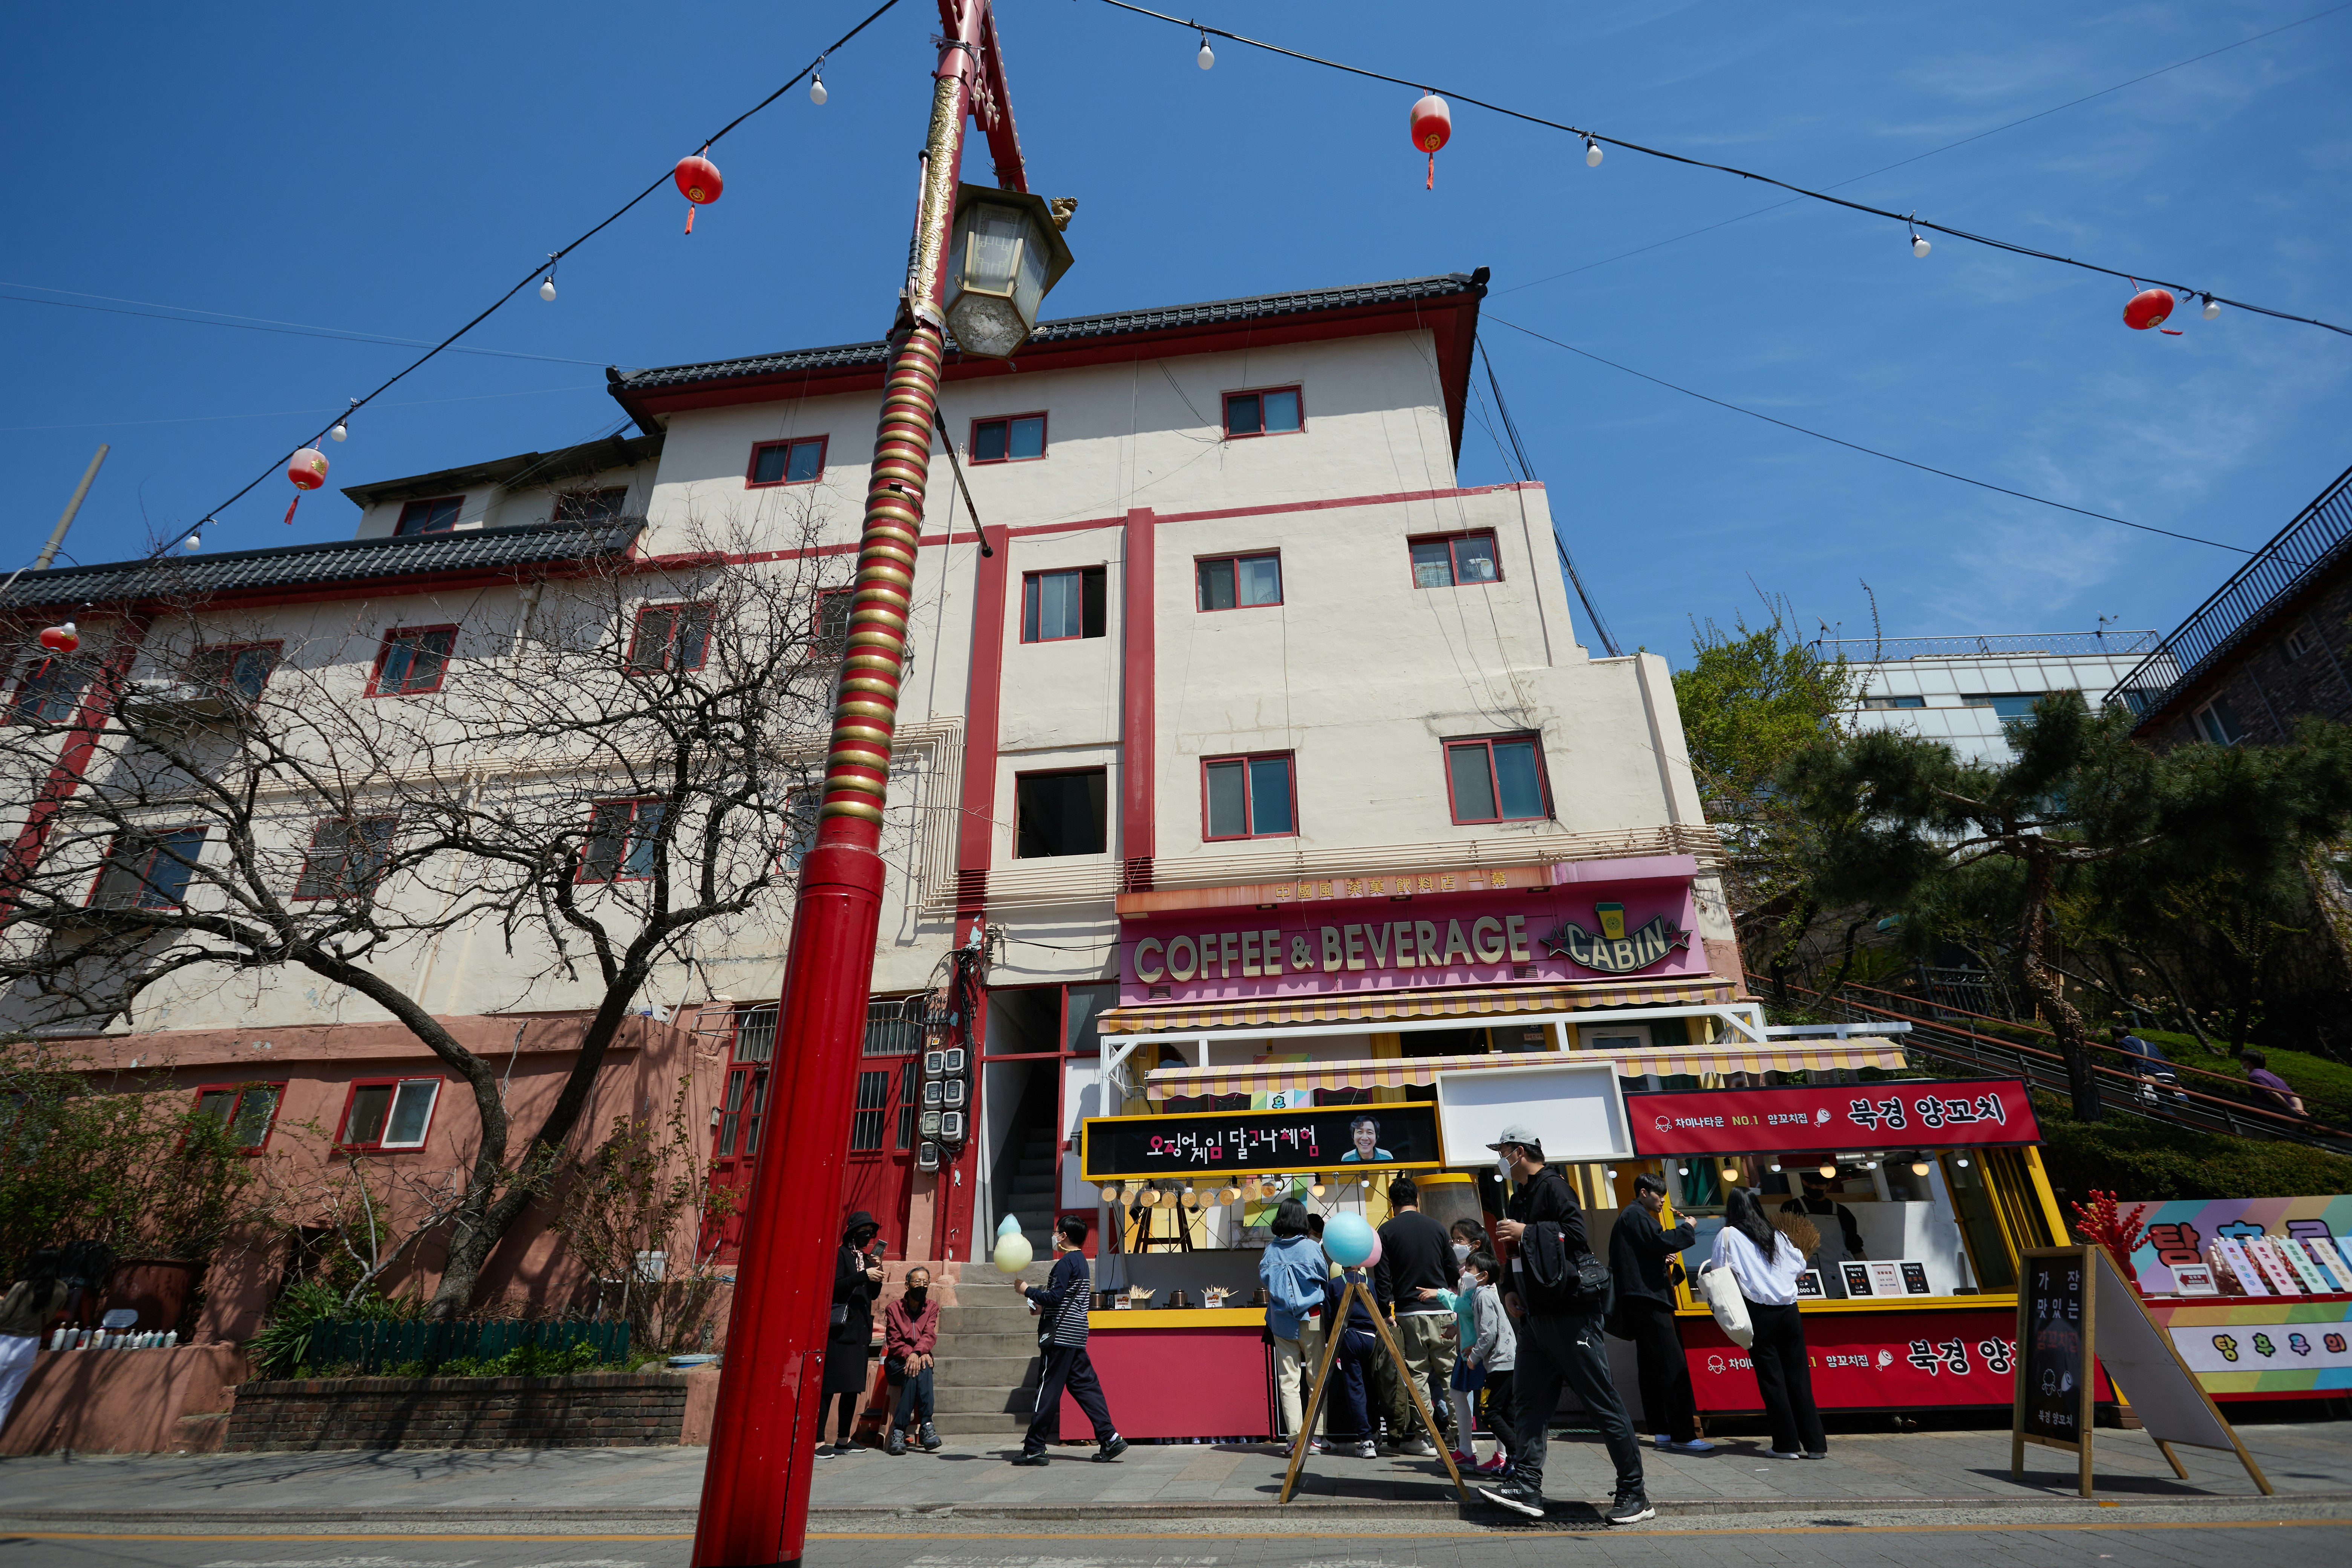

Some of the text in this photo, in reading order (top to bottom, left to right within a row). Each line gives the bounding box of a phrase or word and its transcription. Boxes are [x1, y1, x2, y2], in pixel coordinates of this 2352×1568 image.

[1276, 882, 1334, 900] 中國風
[1347, 879, 1385, 895] 茶菓
[1396, 875, 1455, 893] 飲料店
[1134, 915, 1531, 983] COFFEE & BEVERAGE
[1566, 916, 1667, 970] CABIN
[1675, 1092, 2005, 1131] 차이나타운 NO.1 양꼬치집 북경 양꼬치
[1826, 1355, 1870, 1368] 양꼬치집
[1907, 1337, 1971, 1376] 북경
[2038, 1409, 2073, 1427] 북경 양꼬치
